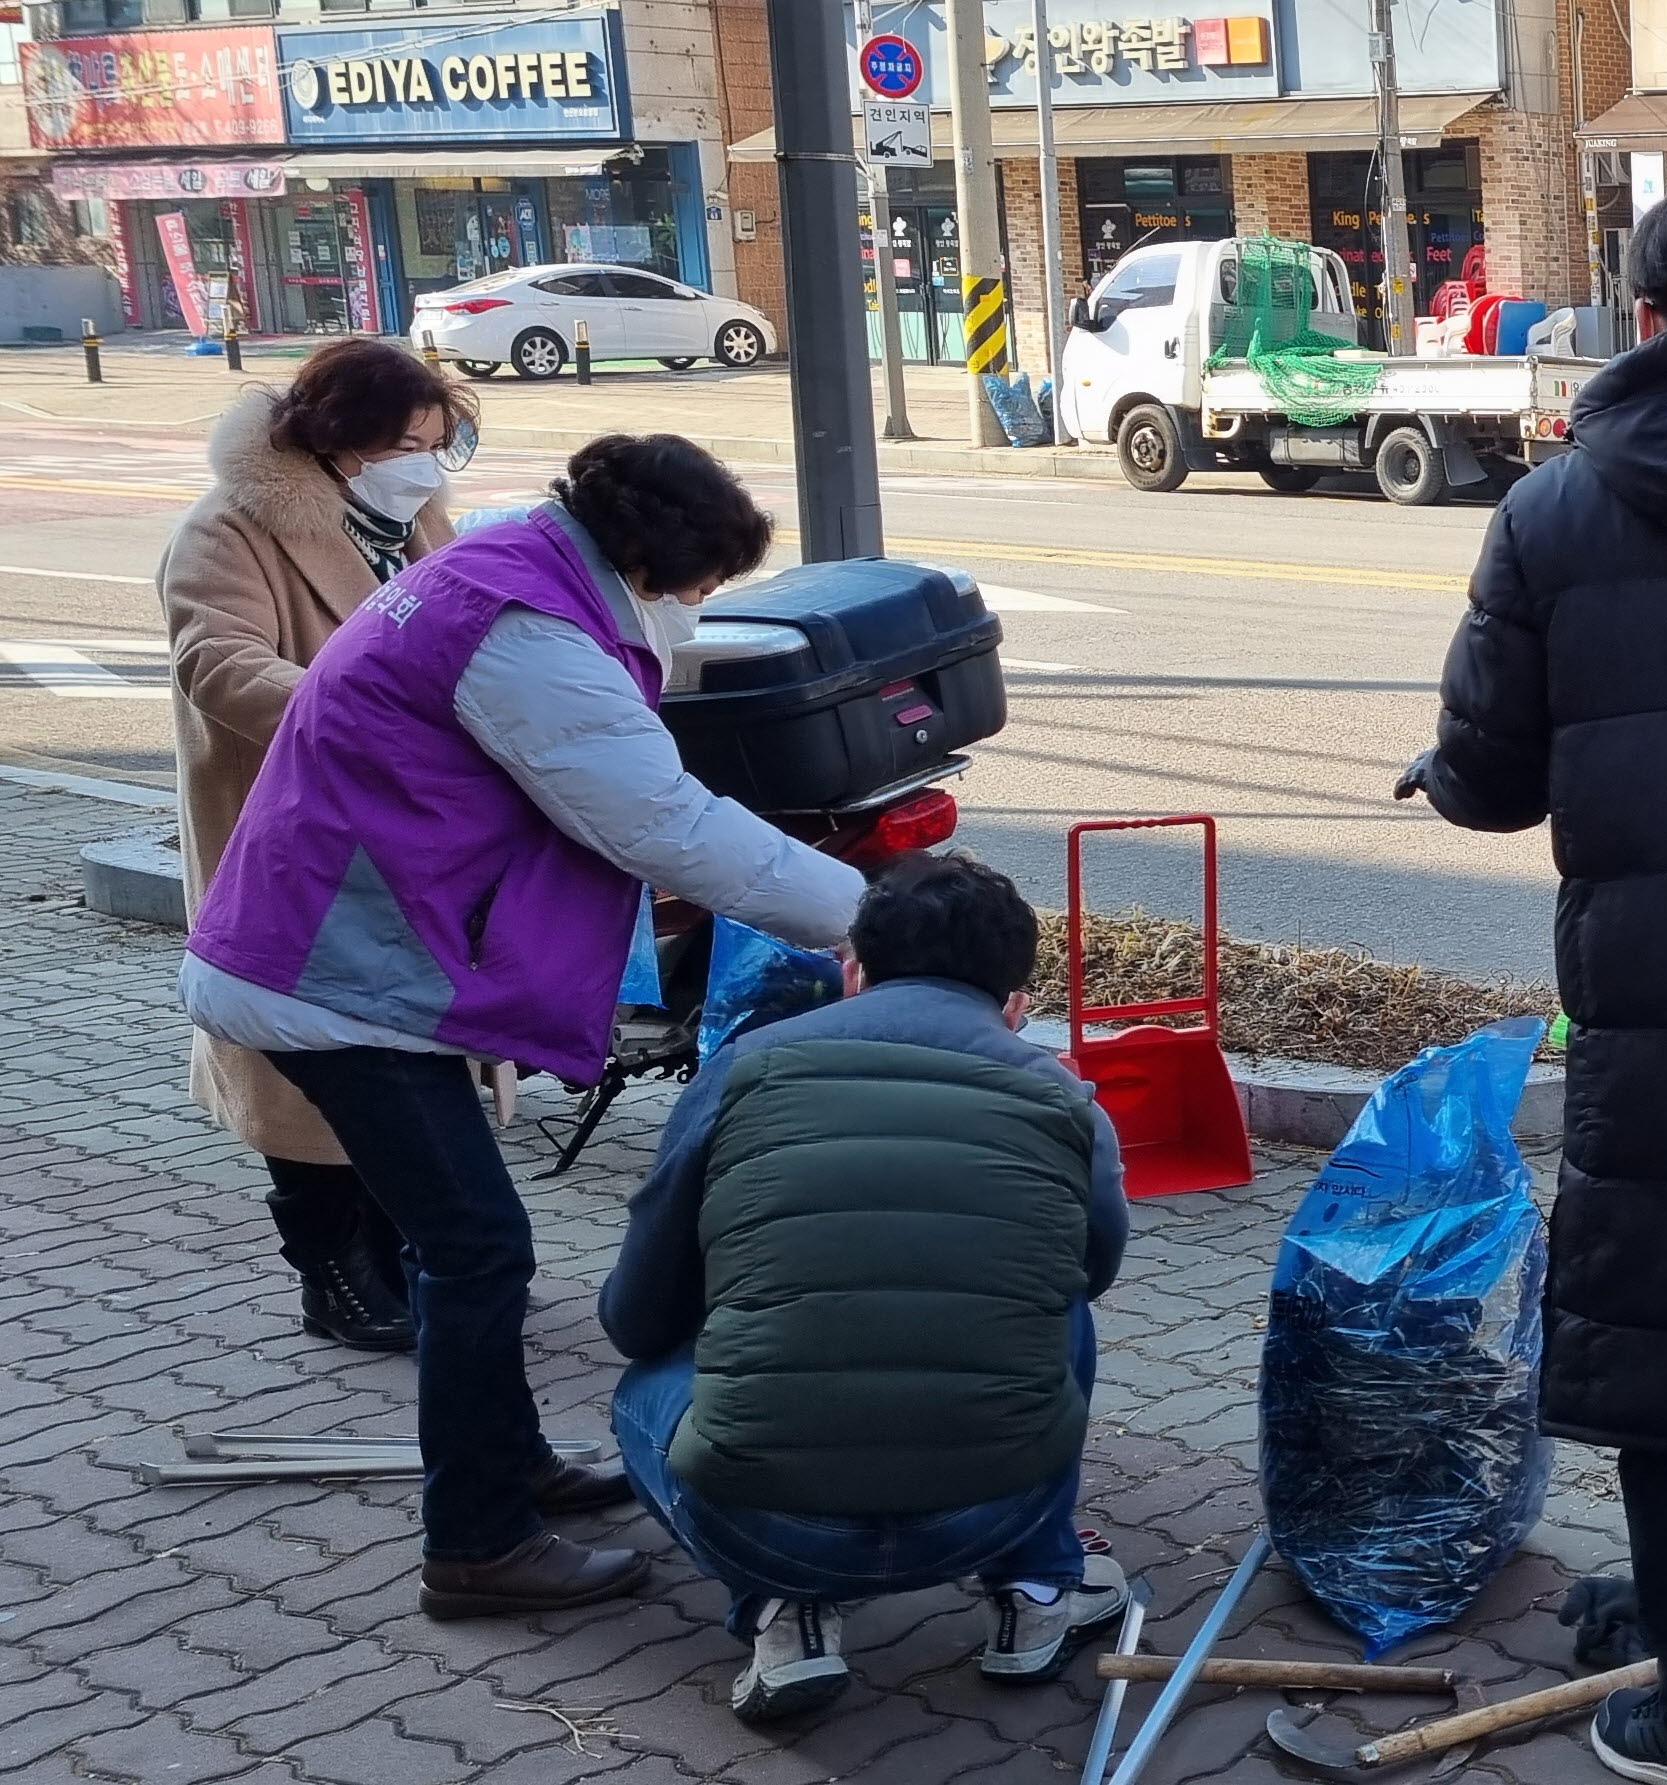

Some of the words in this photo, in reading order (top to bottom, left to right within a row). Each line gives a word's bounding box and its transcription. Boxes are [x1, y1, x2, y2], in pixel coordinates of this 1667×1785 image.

[327, 59, 434, 105] EDIYA
[441, 52, 592, 101] COFFEE
[869, 108, 926, 124] 견인지역
[1333, 211, 1360, 229] King
[1427, 246, 1452, 262] Feet
